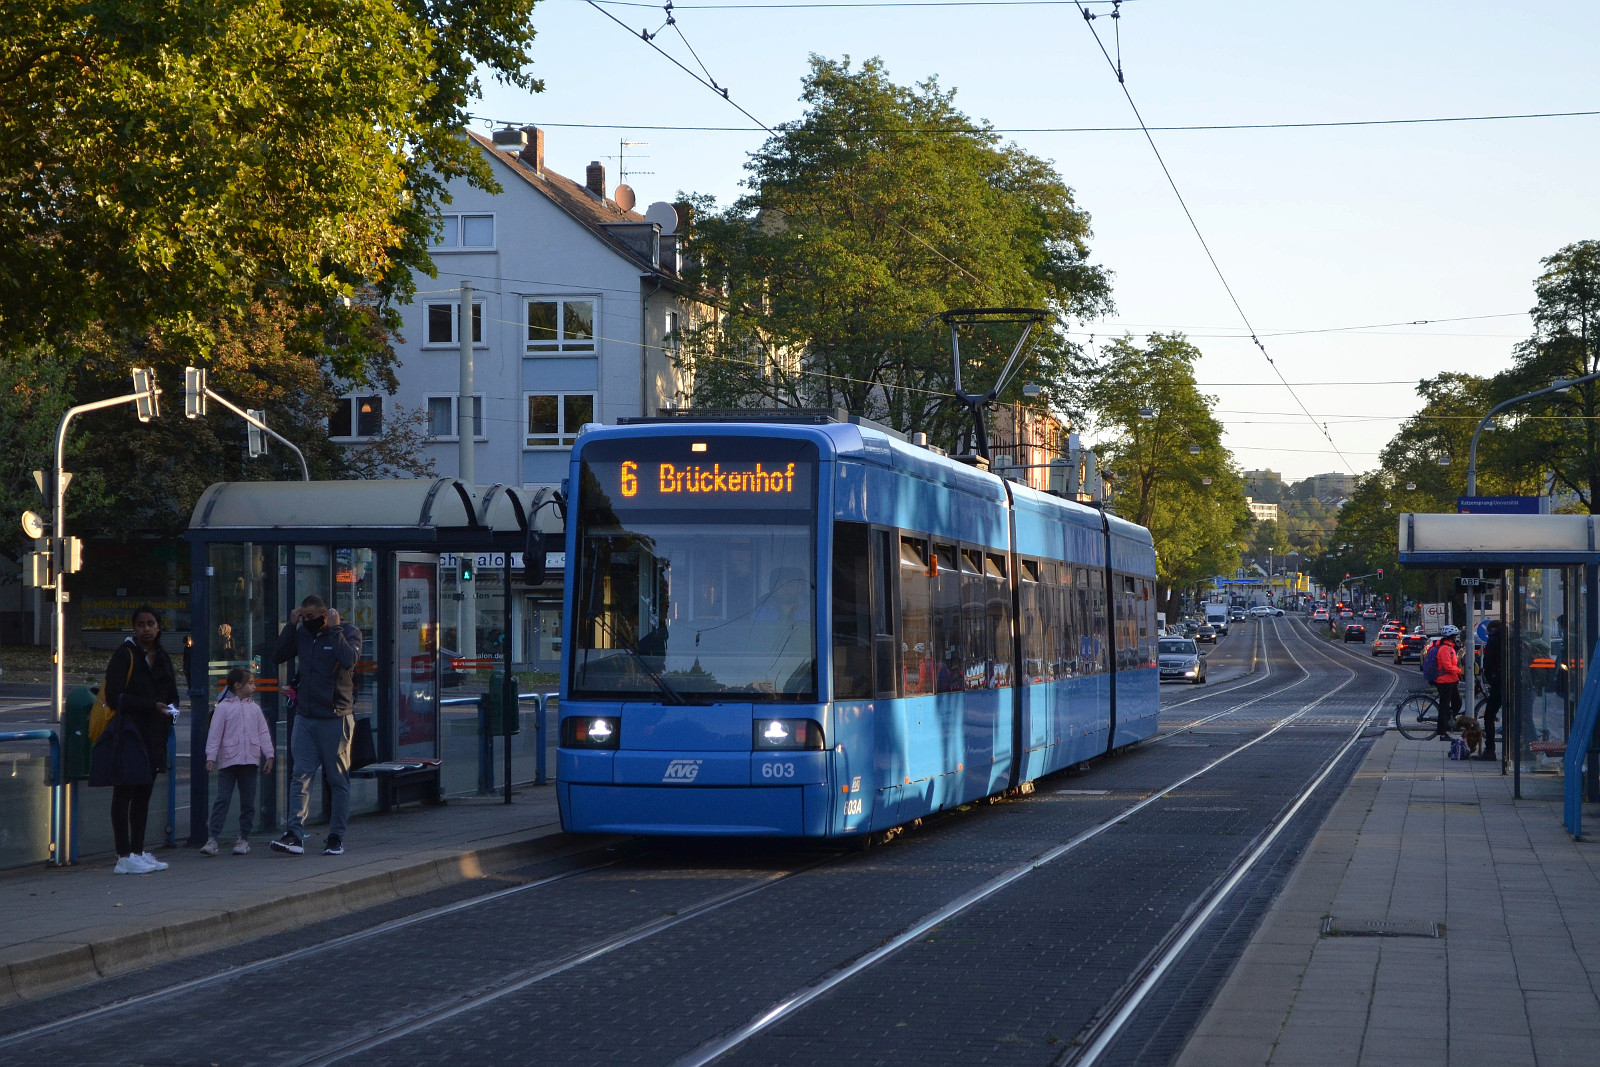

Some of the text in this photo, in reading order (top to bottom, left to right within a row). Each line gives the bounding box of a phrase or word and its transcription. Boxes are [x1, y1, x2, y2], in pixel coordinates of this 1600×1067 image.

[621, 461, 795, 497] 6 Brückenhof
[477, 554, 515, 566] alon
[663, 763, 700, 779] KVG
[761, 763, 795, 778] 603
[843, 798, 862, 816] 603A
